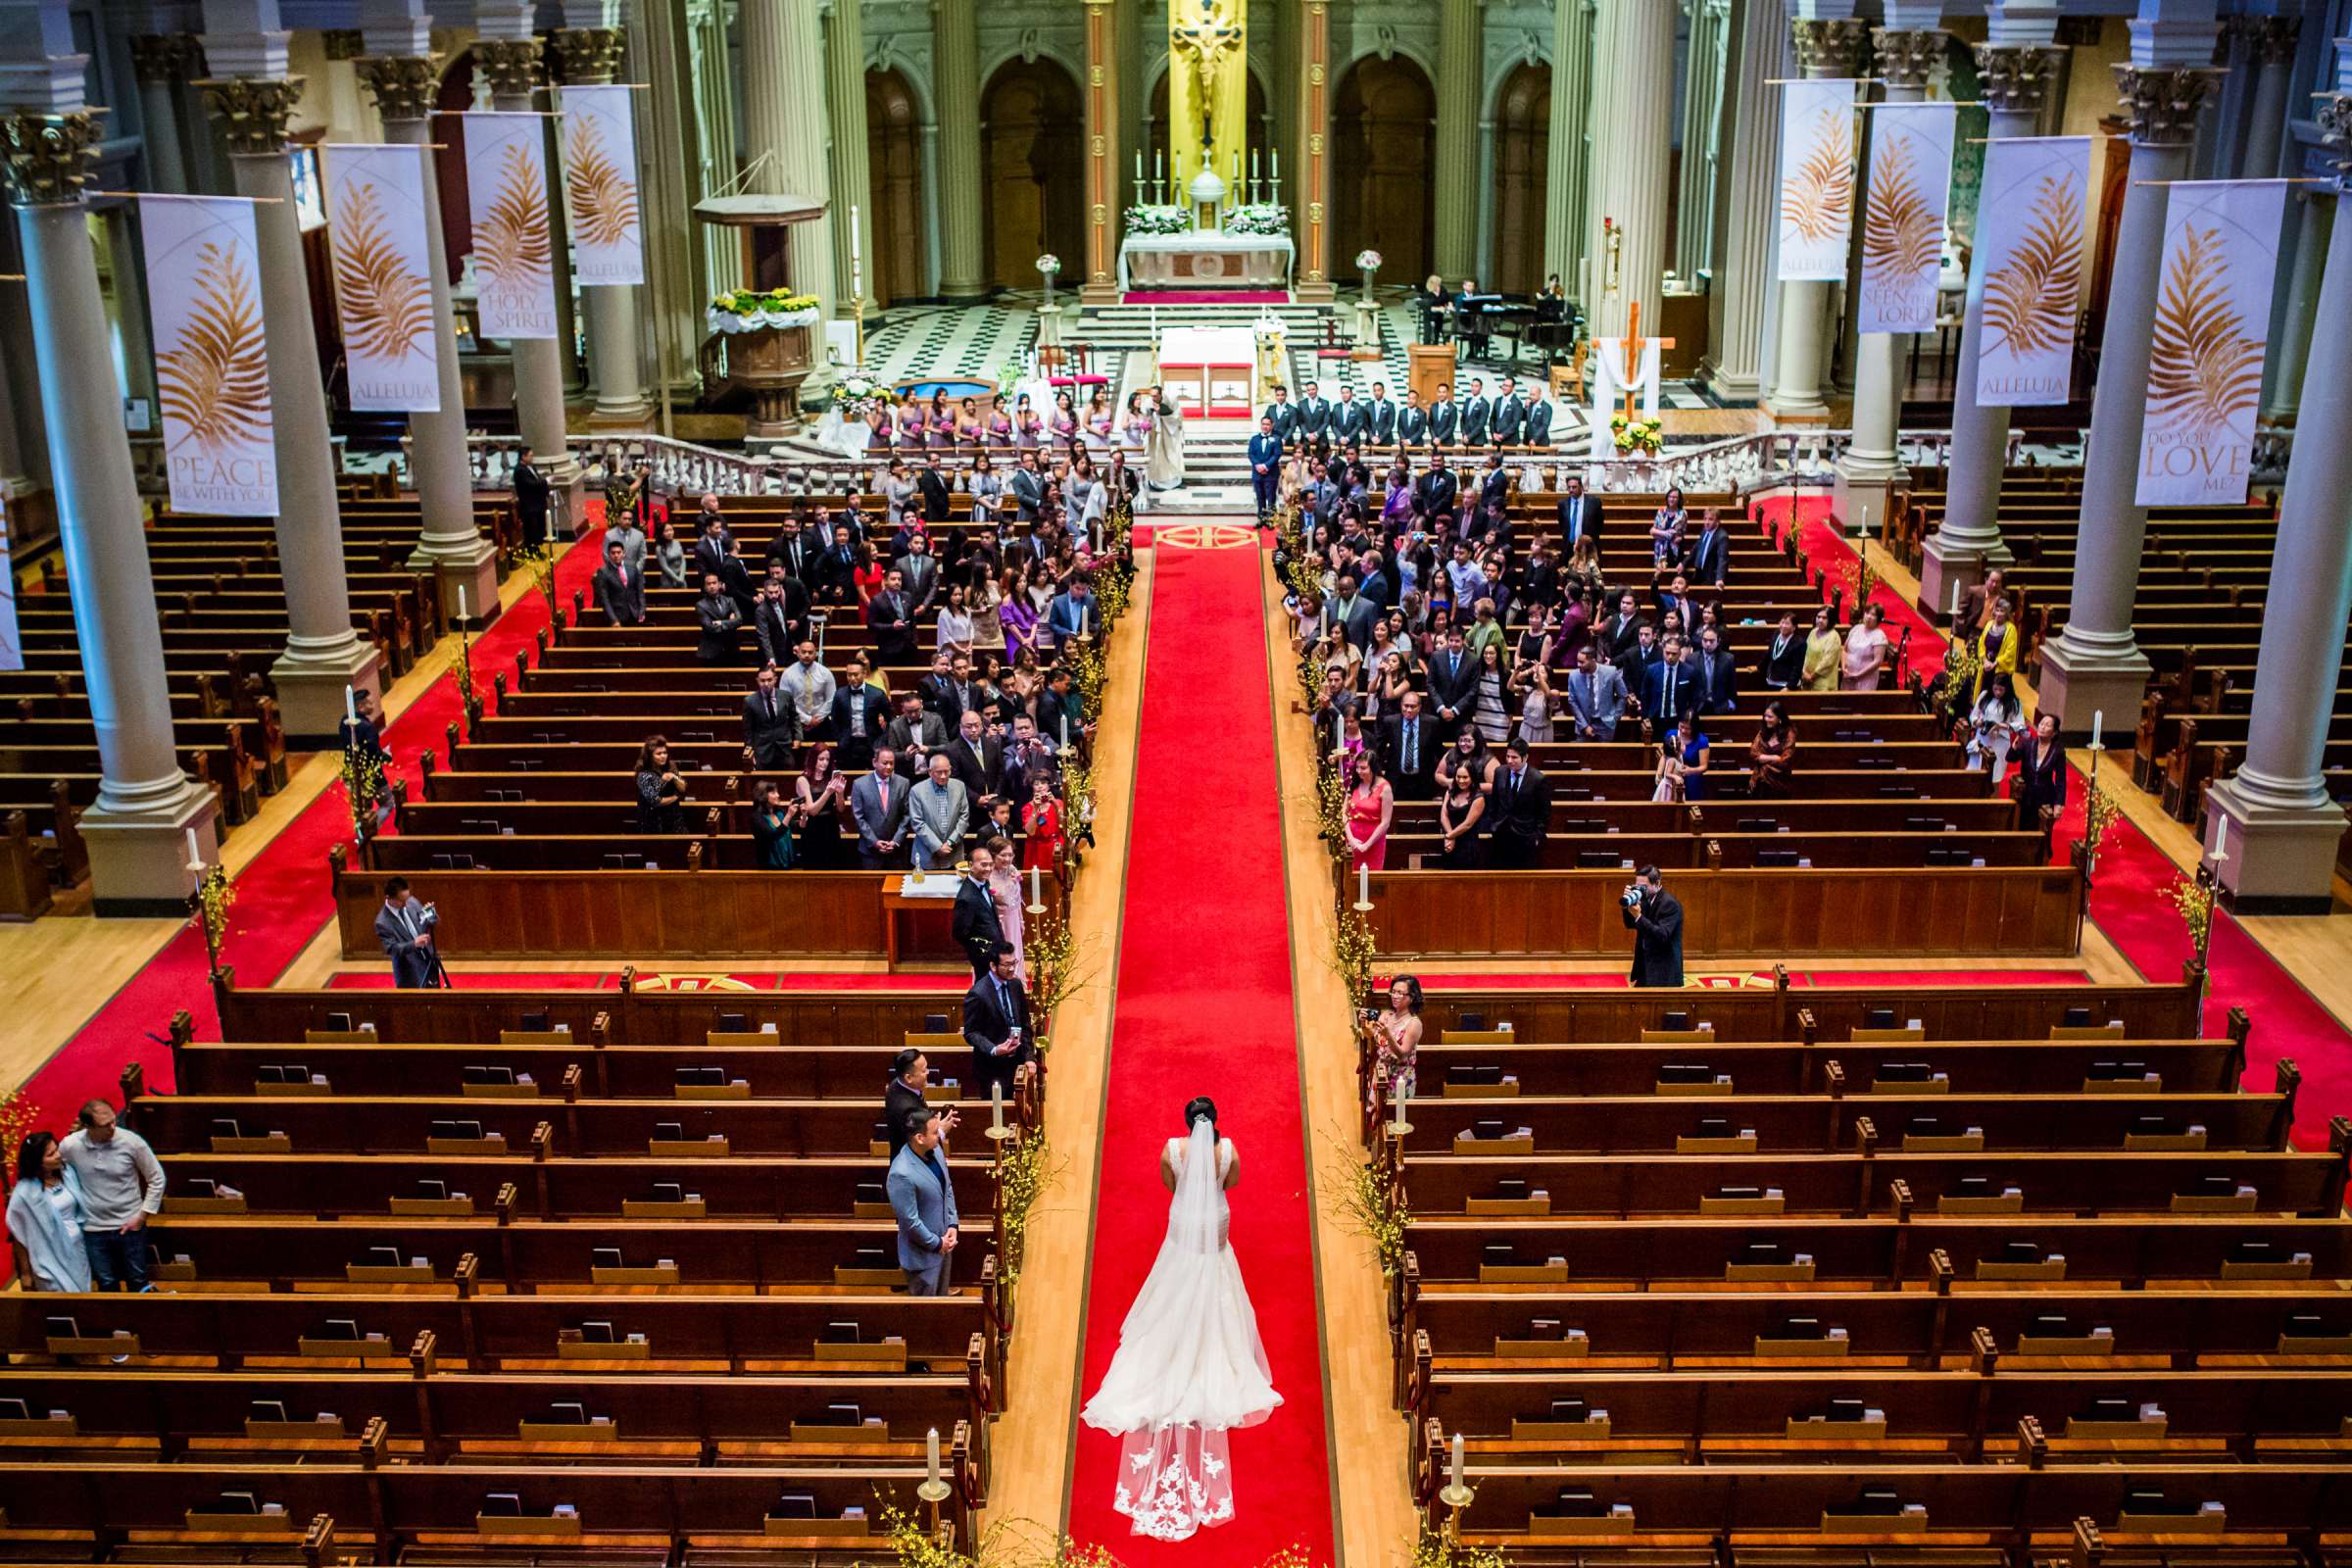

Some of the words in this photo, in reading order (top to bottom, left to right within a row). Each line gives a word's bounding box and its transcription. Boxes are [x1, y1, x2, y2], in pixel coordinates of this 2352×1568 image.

[487, 294, 538, 311] HOLY
[1864, 288, 1909, 305] SEEN
[495, 312, 551, 329] SPIRIT
[1878, 305, 1931, 322] LORD
[353, 382, 435, 400] ALLELUIA
[1982, 375, 2064, 394] ALLELUIA
[2148, 431, 2173, 445] DO
[2178, 431, 2213, 445] YOU
[2146, 445, 2247, 477] LOVE
[172, 455, 273, 487] PEACE
[2203, 477, 2235, 492] ME?
[174, 486, 190, 499] BE
[193, 486, 235, 501] WITH
[238, 488, 271, 502] YOU
